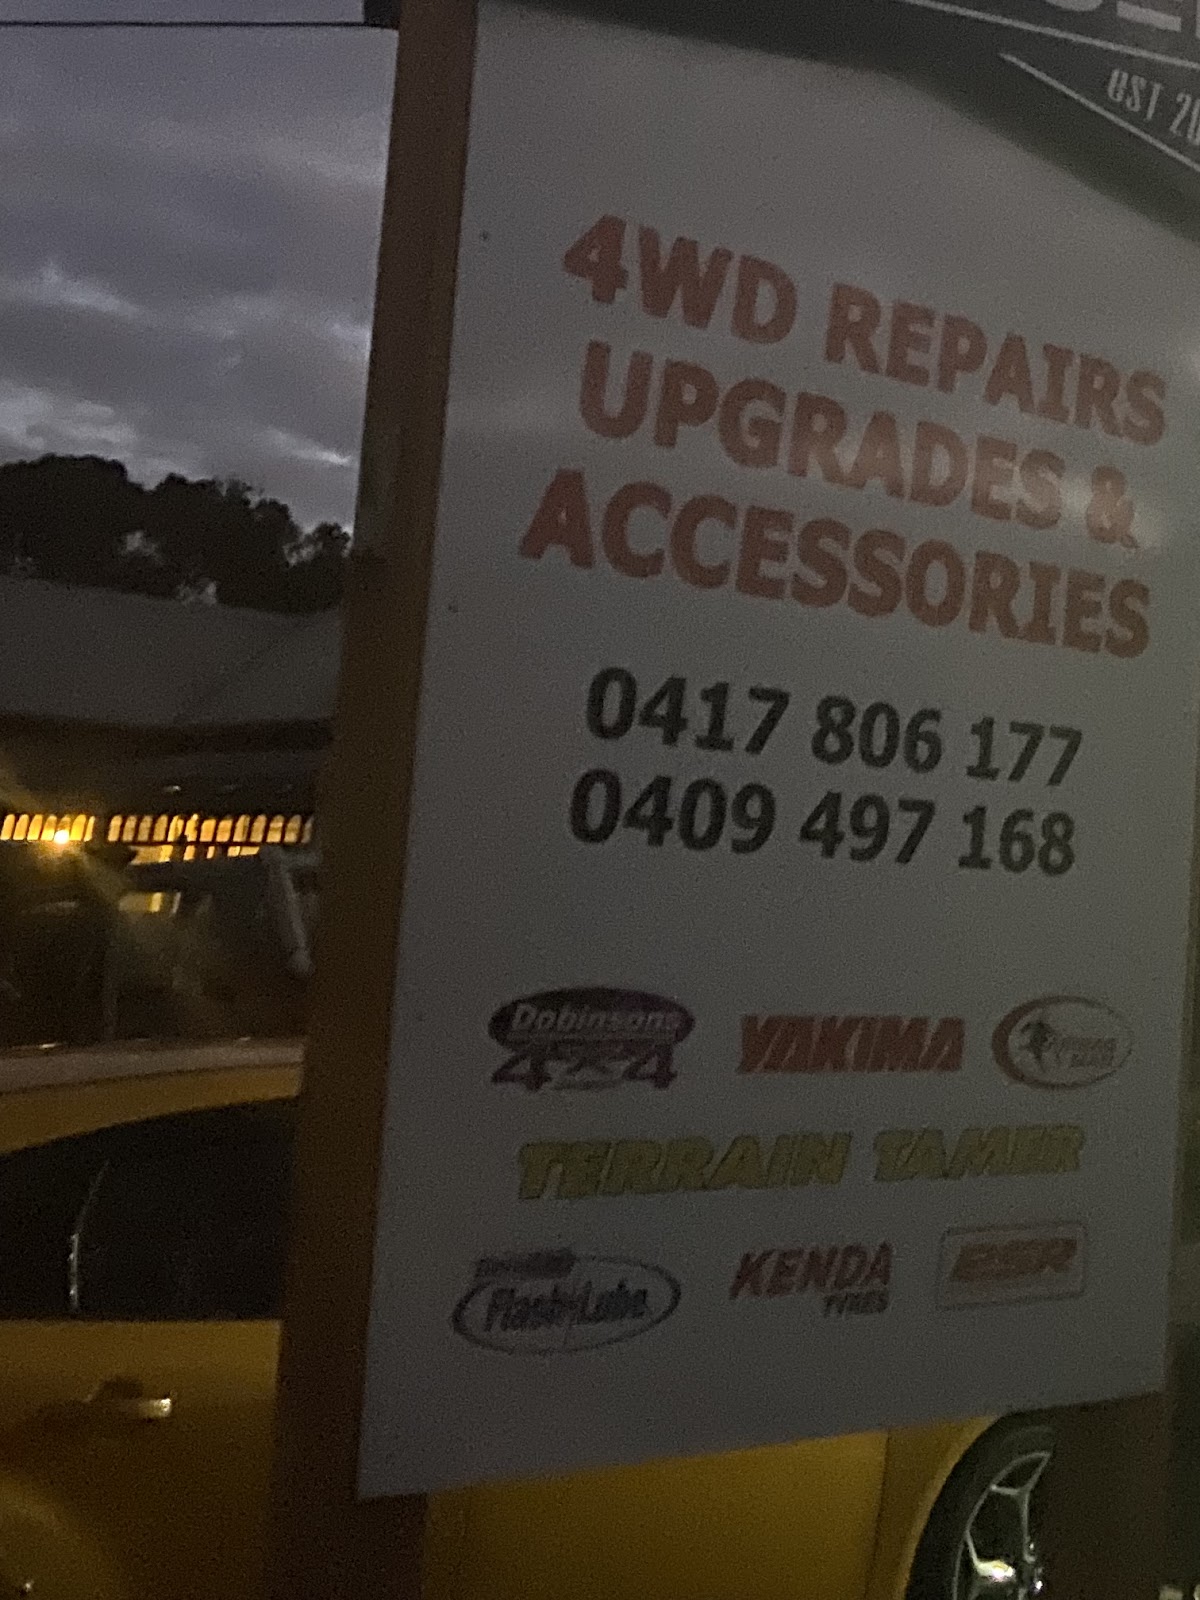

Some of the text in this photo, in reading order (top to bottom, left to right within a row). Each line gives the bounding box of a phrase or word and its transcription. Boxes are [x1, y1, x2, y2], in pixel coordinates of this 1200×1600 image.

[562, 213, 1169, 447] 4WD REPAIRS
[578, 339, 1139, 550] UPGRADES &
[518, 466, 1152, 659] ACCESSORIES
[585, 666, 1083, 787] 0417 806 177
[567, 767, 1077, 877] 0409 497 168
[509, 1003, 683, 1032] Dobinsons
[735, 1014, 966, 1073] YAKIMA
[517, 1123, 1086, 1201] TERRAIN TAMER
[728, 1240, 893, 1301] KENDA
